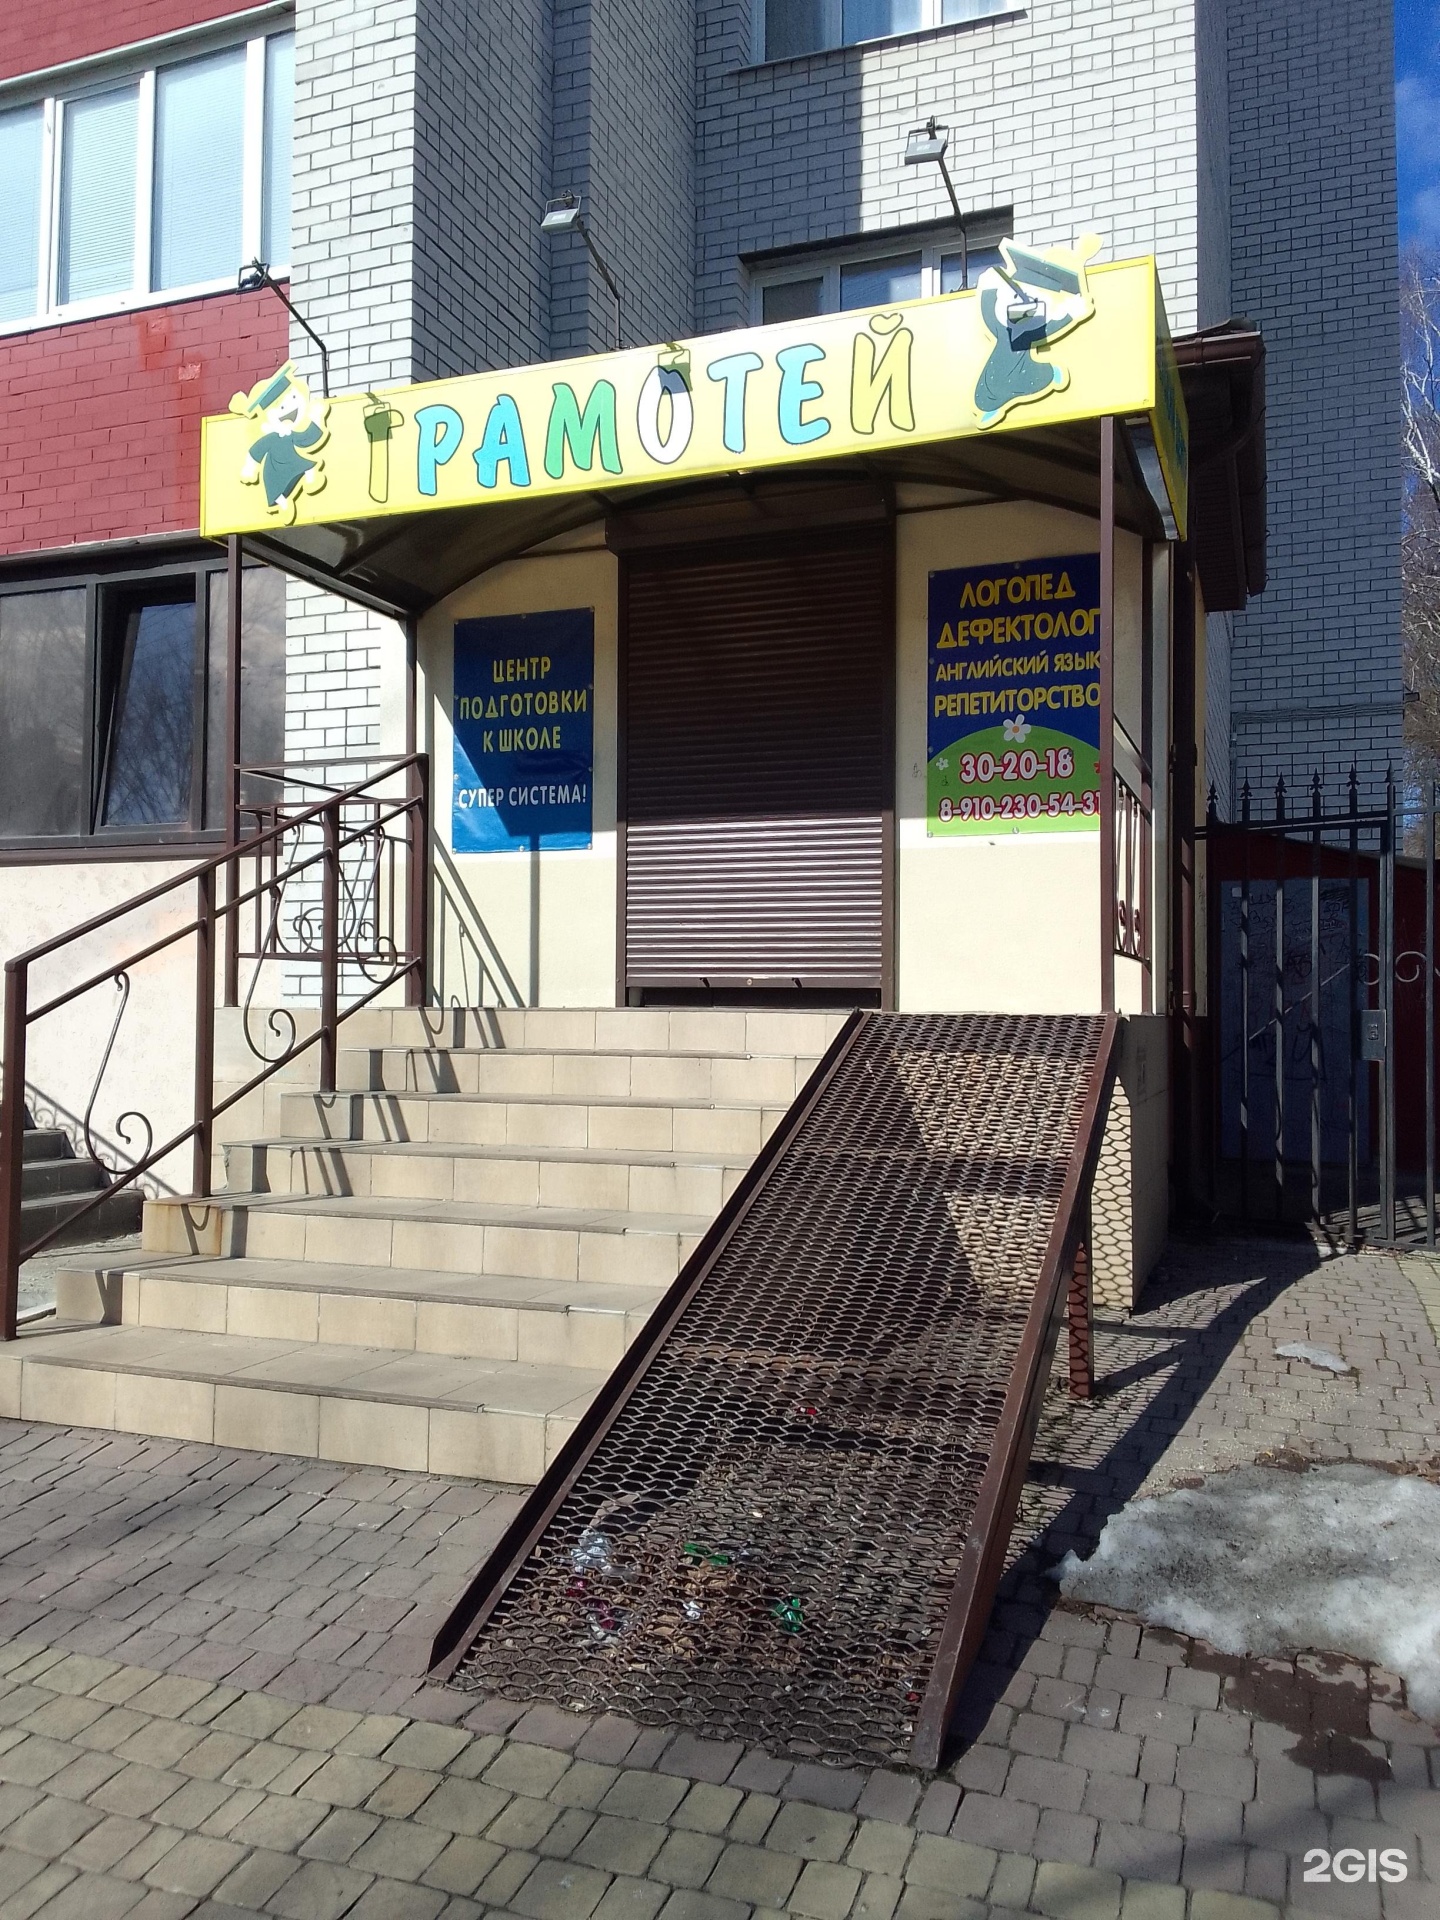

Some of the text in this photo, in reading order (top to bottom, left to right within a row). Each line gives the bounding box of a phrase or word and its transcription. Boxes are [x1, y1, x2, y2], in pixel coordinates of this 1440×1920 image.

[366, 313, 916, 503] ГРАМОТЕЙ
[960, 571, 1076, 608] ЛОГОПЕД
[936, 608, 1100, 649] ДЕФЕКТОЛОГ
[493, 656, 552, 683] ЦЕНТР
[935, 650, 1100, 682] АНГЛИЙСКИЙ ЯЗЫК
[459, 689, 588, 720] ПОДГОТОВКИ
[934, 683, 1100, 718] РЕПЕТИТОРСТВО
[483, 726, 561, 753] К ШКОЛЕ
[960, 748, 1074, 783] 30-20-18
[458, 784, 587, 809] СУПЕР СИСТЕМА!
